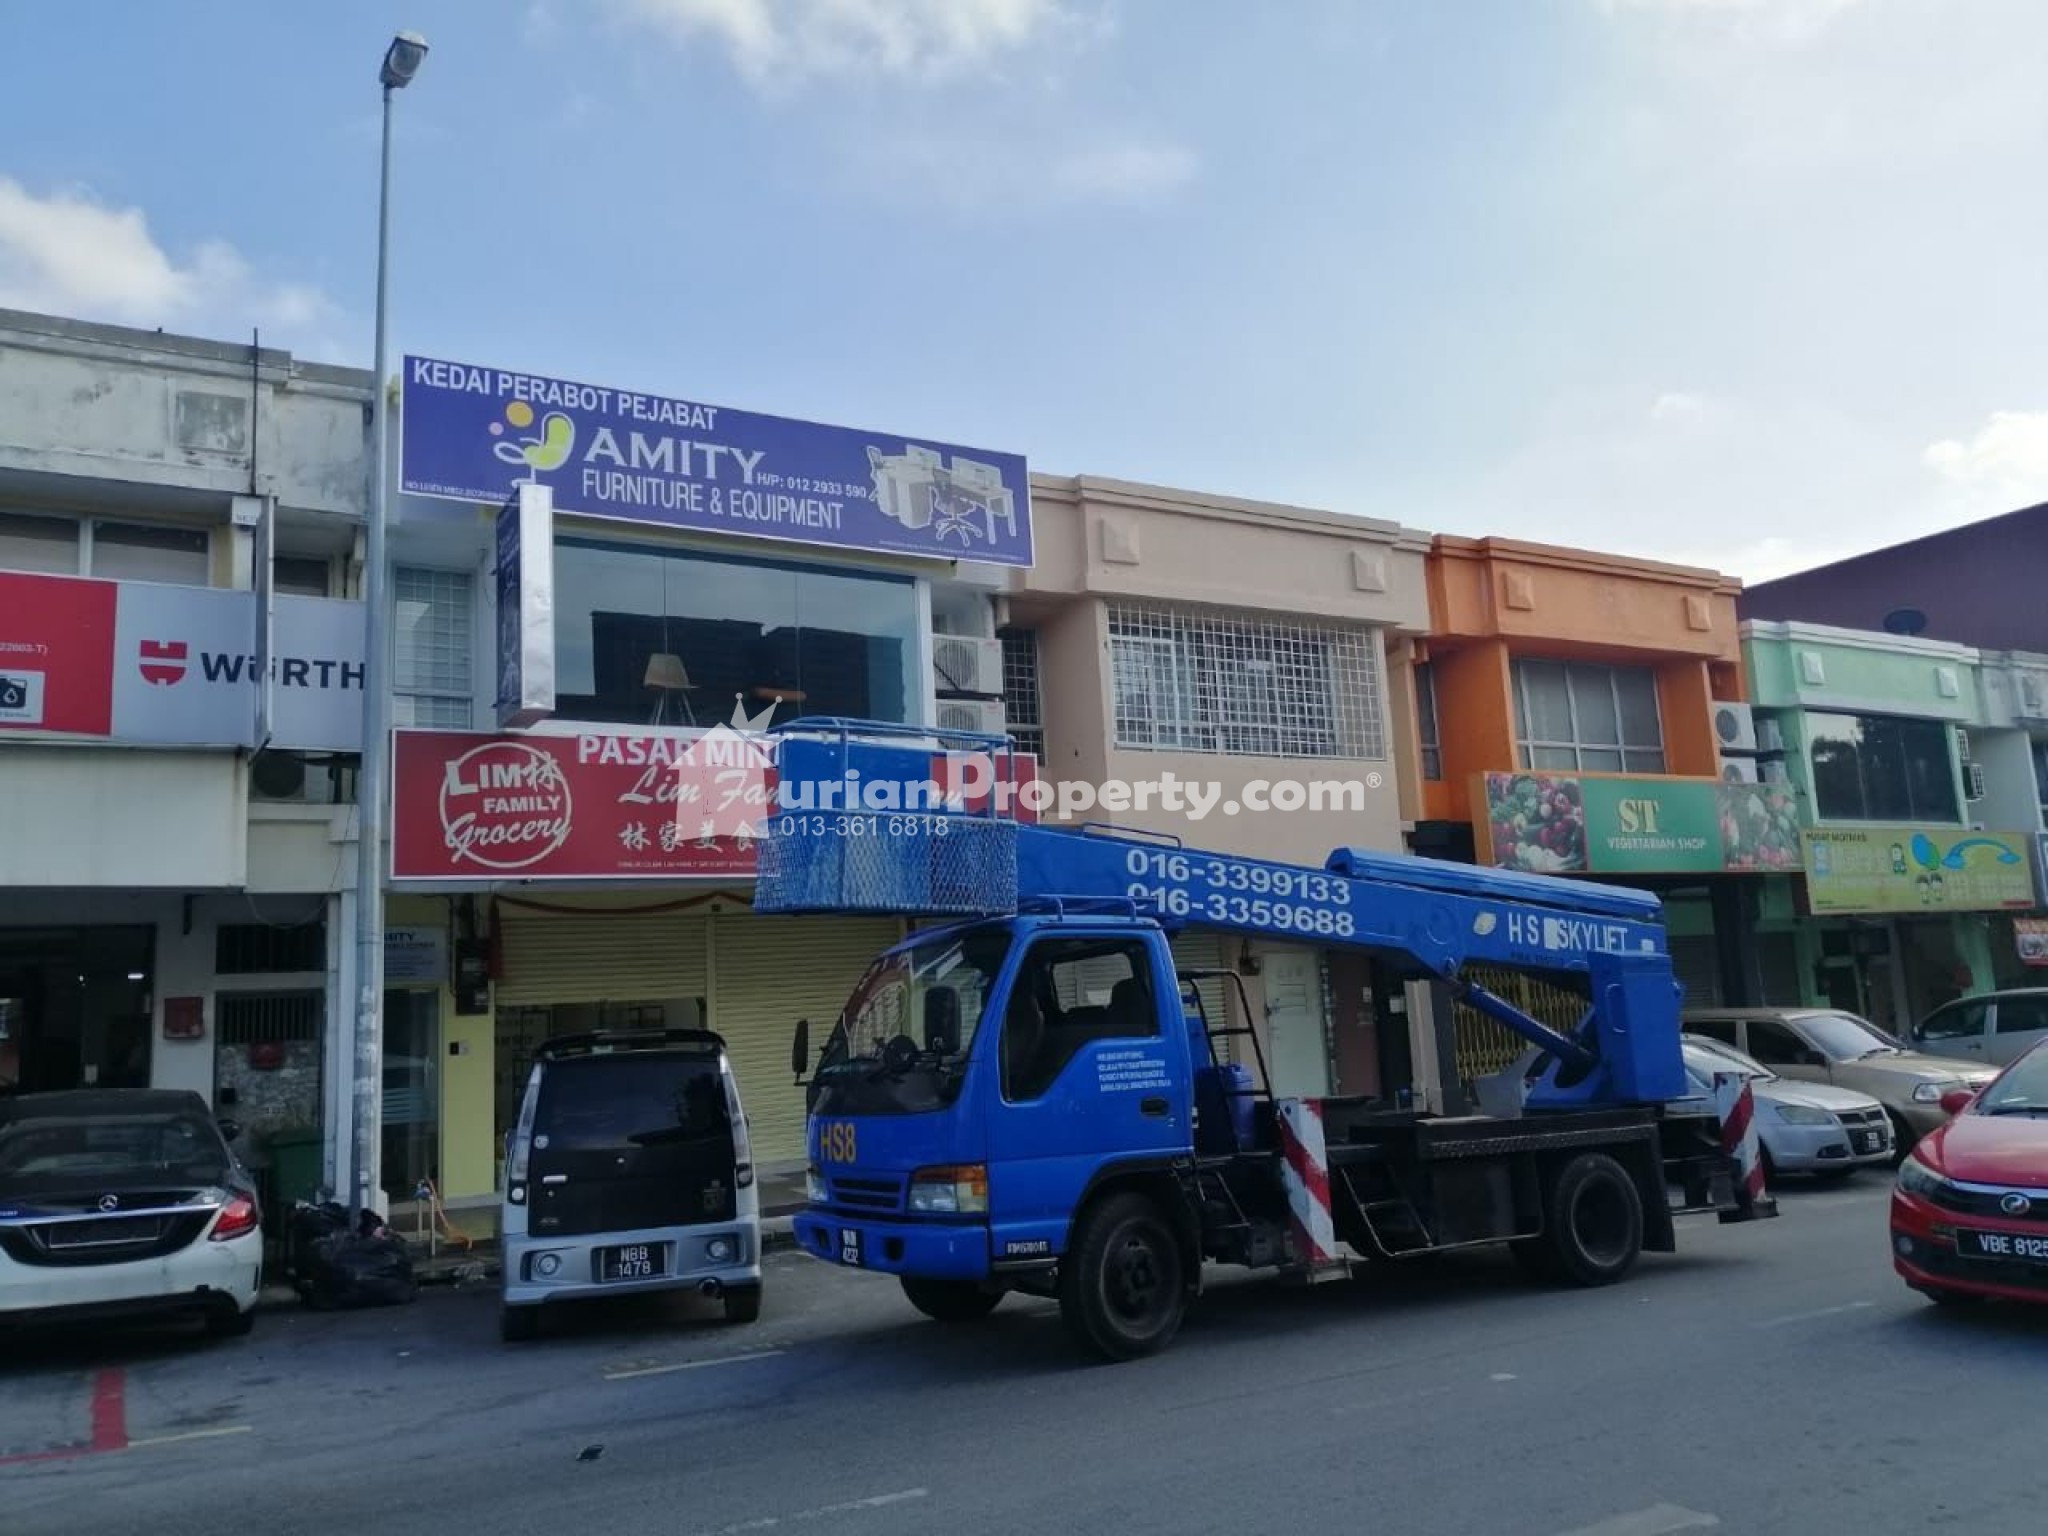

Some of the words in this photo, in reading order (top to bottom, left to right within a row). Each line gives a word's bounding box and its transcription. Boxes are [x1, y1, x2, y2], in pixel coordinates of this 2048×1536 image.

[414, 359, 491, 395] KEDAI
[497, 372, 612, 414] PERABOT
[617, 393, 718, 431] PEJABAT
[583, 426, 767, 485] AMITY
[583, 467, 704, 512] FURNITURE
[710, 487, 724, 515] &
[729, 488, 844, 530] EQUIPMENT
[786, 476, 809, 492] 012
[812, 479, 842, 496] 2933
[578, 735, 697, 769] PASAR
[445, 760, 522, 795] LIM
[483, 795, 561, 814] FAMILY
[1618, 799, 1660, 833] ST
[444, 812, 573, 864] Grocery
[1126, 849, 1351, 905] 016-3399133
[1127, 882, 1355, 937] 016-3359688
[820, 1123, 857, 1163] HS8
[1979, 1233, 2011, 1254] VBE
[617, 1260, 651, 1278] 1478
